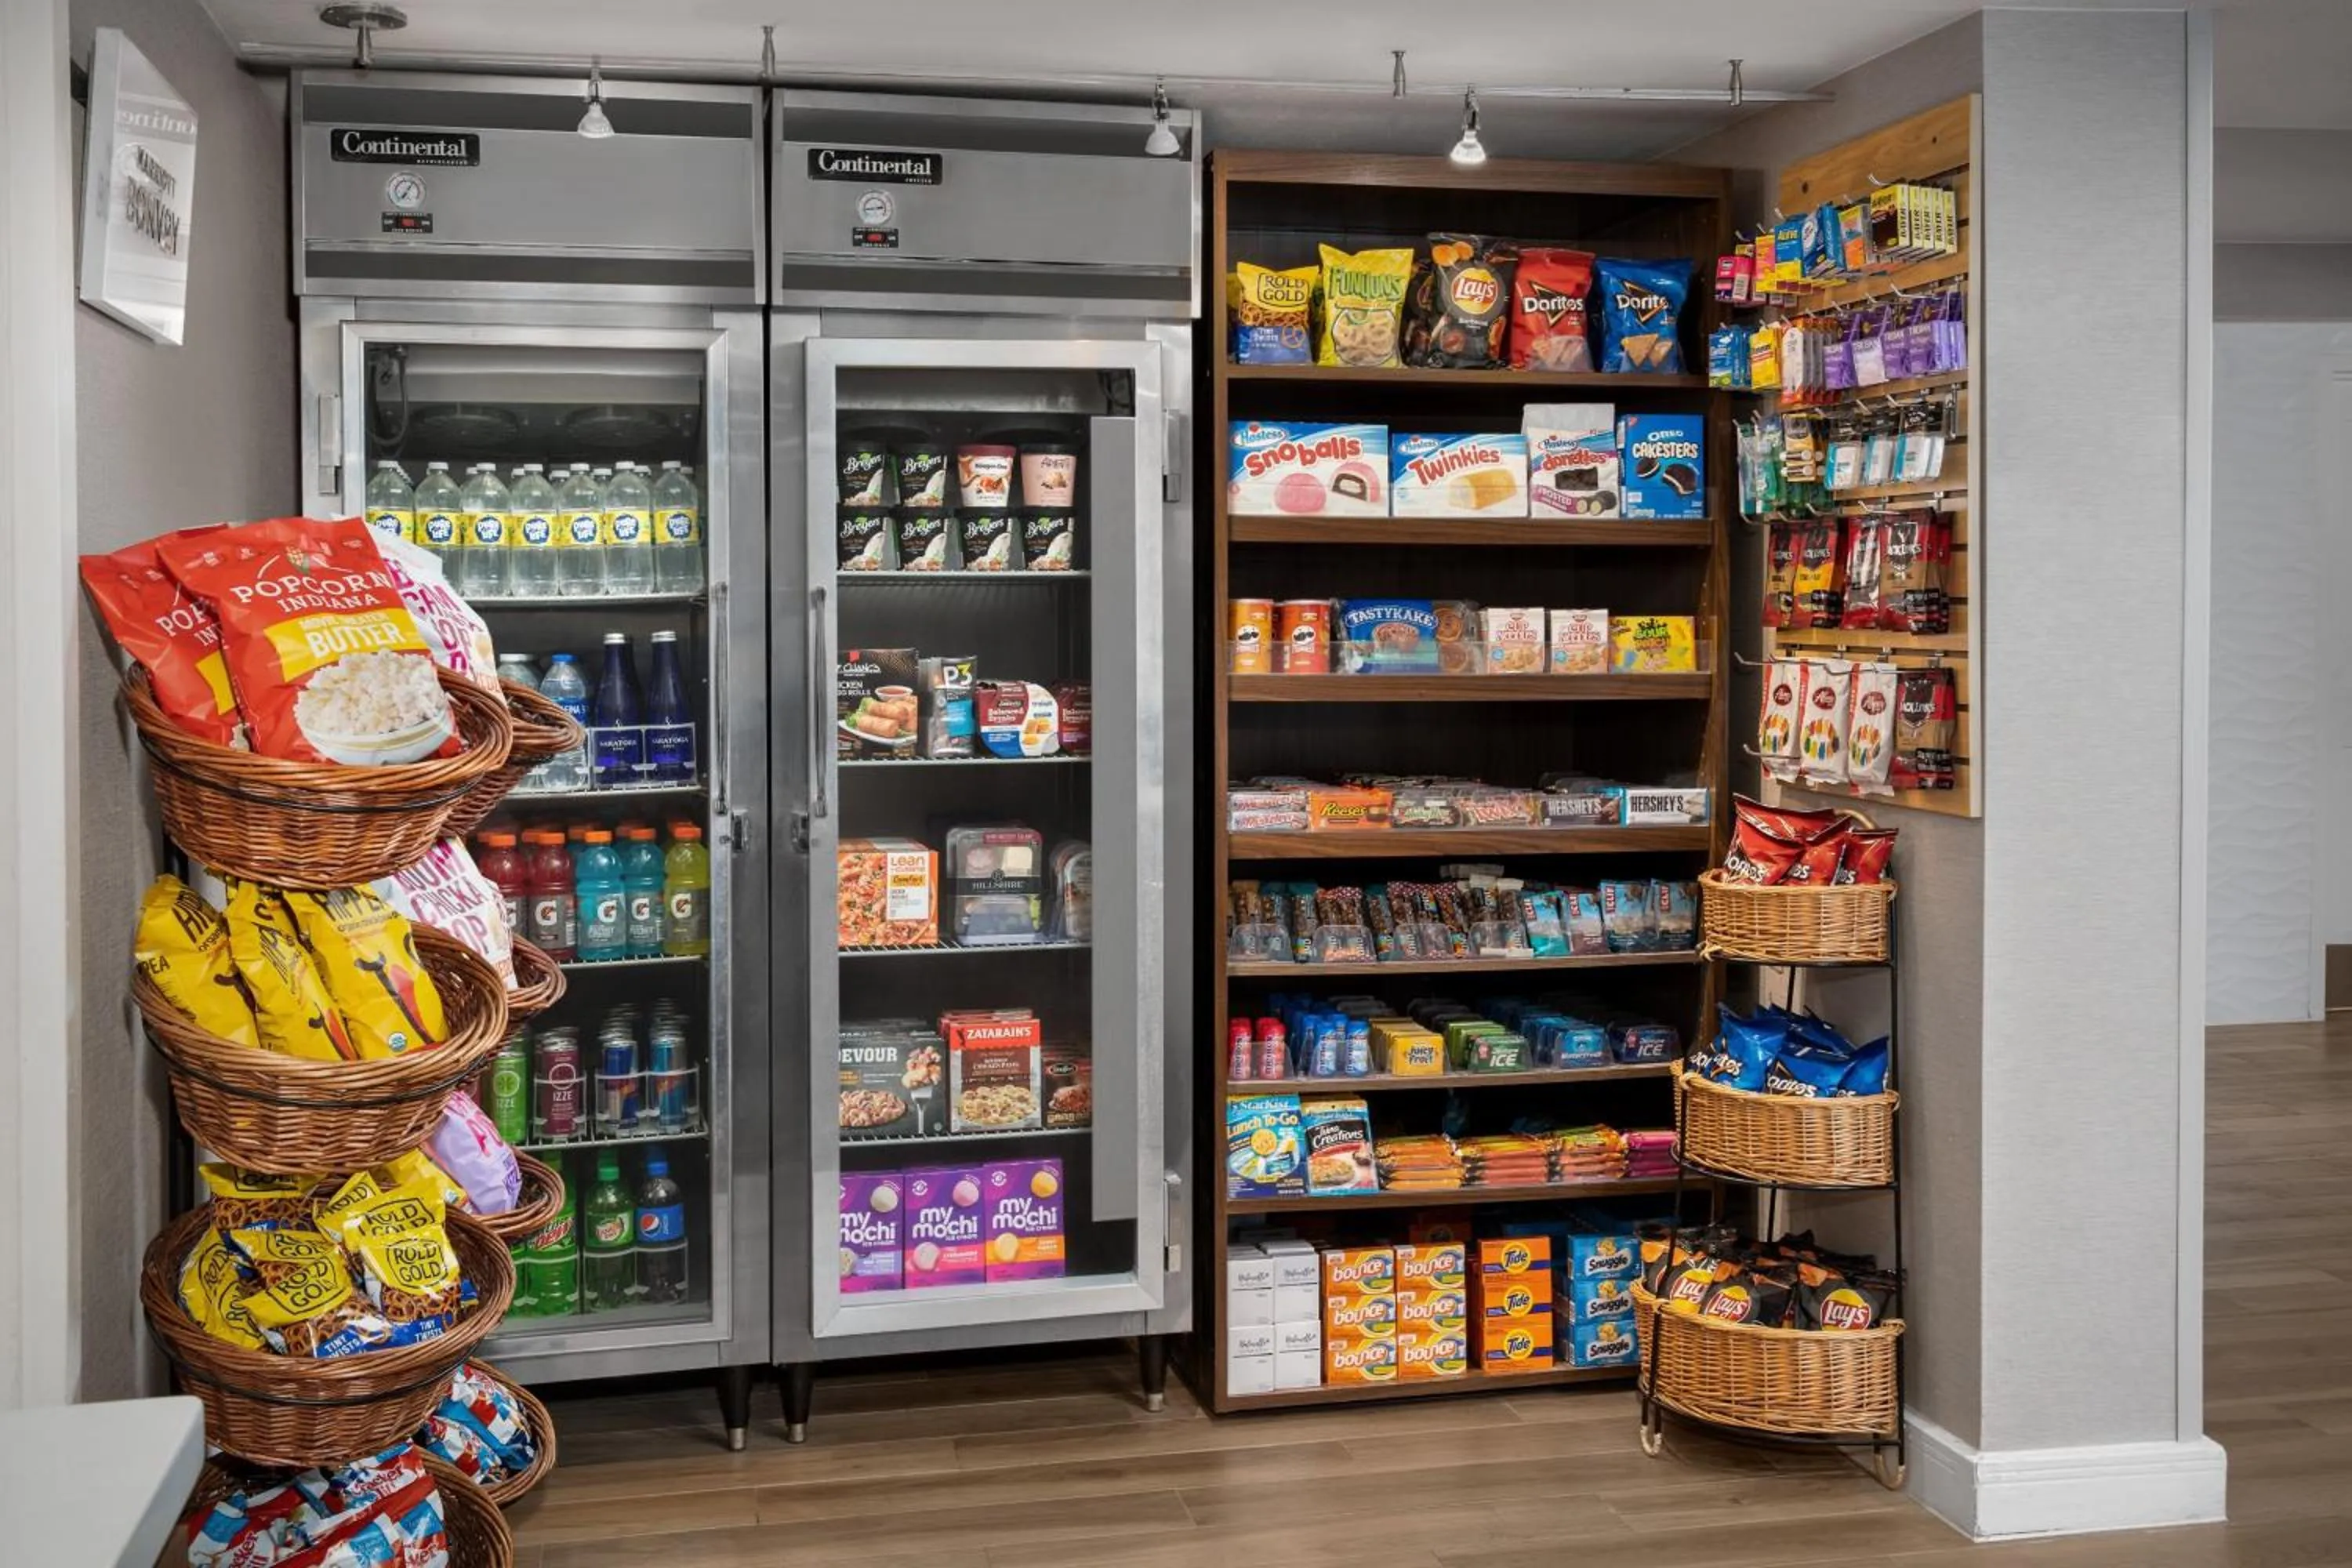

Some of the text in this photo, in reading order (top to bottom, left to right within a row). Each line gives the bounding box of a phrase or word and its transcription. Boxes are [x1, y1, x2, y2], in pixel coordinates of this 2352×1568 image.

[343, 132, 466, 156] Continental
[818, 151, 931, 175] Continental
[1264, 276, 1305, 289] ROLD
[1330, 267, 1403, 301] FUNYUNS
[1263, 288, 1305, 301] GOLD
[1524, 296, 1584, 312] Doritos
[1240, 430, 1284, 443] Hostess
[1632, 442, 1698, 459] CAKESTERS
[844, 456, 882, 474] Breyers
[902, 456, 942, 474] Breyers
[1408, 445, 1501, 486] Twinkies
[840, 518, 881, 539] Breyers
[902, 518, 942, 539] Breyers
[965, 518, 1005, 538] Breyers
[1025, 518, 1065, 539] Breyers
[230, 572, 394, 603] POPCORN
[277, 593, 382, 612] INDIANA
[1348, 608, 1435, 626] TASTYKAKE
[306, 622, 406, 659] BUTTER
[943, 664, 973, 688] P3
[535, 900, 557, 927] G
[597, 899, 617, 924] G
[631, 898, 651, 921] G
[670, 893, 692, 920] G
[967, 1026, 1033, 1040] ZATARAIN'S
[1490, 1054, 1518, 1066] ICE
[1637, 1044, 1662, 1057] ICE
[552, 1091, 573, 1102] IZZE
[1313, 1129, 1363, 1149] Creations
[920, 1206, 953, 1225] my
[1000, 1197, 1033, 1215] my
[913, 1216, 978, 1239] mochi
[993, 1205, 1058, 1230] mochi
[394, 1243, 437, 1265] ROLD
[1504, 1252, 1528, 1269] Tide
[1588, 1254, 1628, 1272] Snuggle
[398, 1261, 441, 1283] GOLD
[1334, 1259, 1384, 1283] bounce
[1404, 1254, 1454, 1277] bounce
[1334, 1301, 1385, 1327] bounce
[1403, 1297, 1454, 1320] bounce
[1507, 1295, 1530, 1312] Tide
[1589, 1297, 1628, 1314] Snuggle
[1711, 1294, 1747, 1318] Lay's
[420, 1319, 436, 1330] TINY
[1825, 1301, 1869, 1329] Lay's
[324, 1334, 347, 1353] TINY
[1405, 1339, 1456, 1363] bounce
[1508, 1338, 1531, 1355] Tide
[1589, 1340, 1630, 1357] Snuggle
[1334, 1345, 1386, 1369] bounce
[354, 1462, 404, 1496] Cracker
